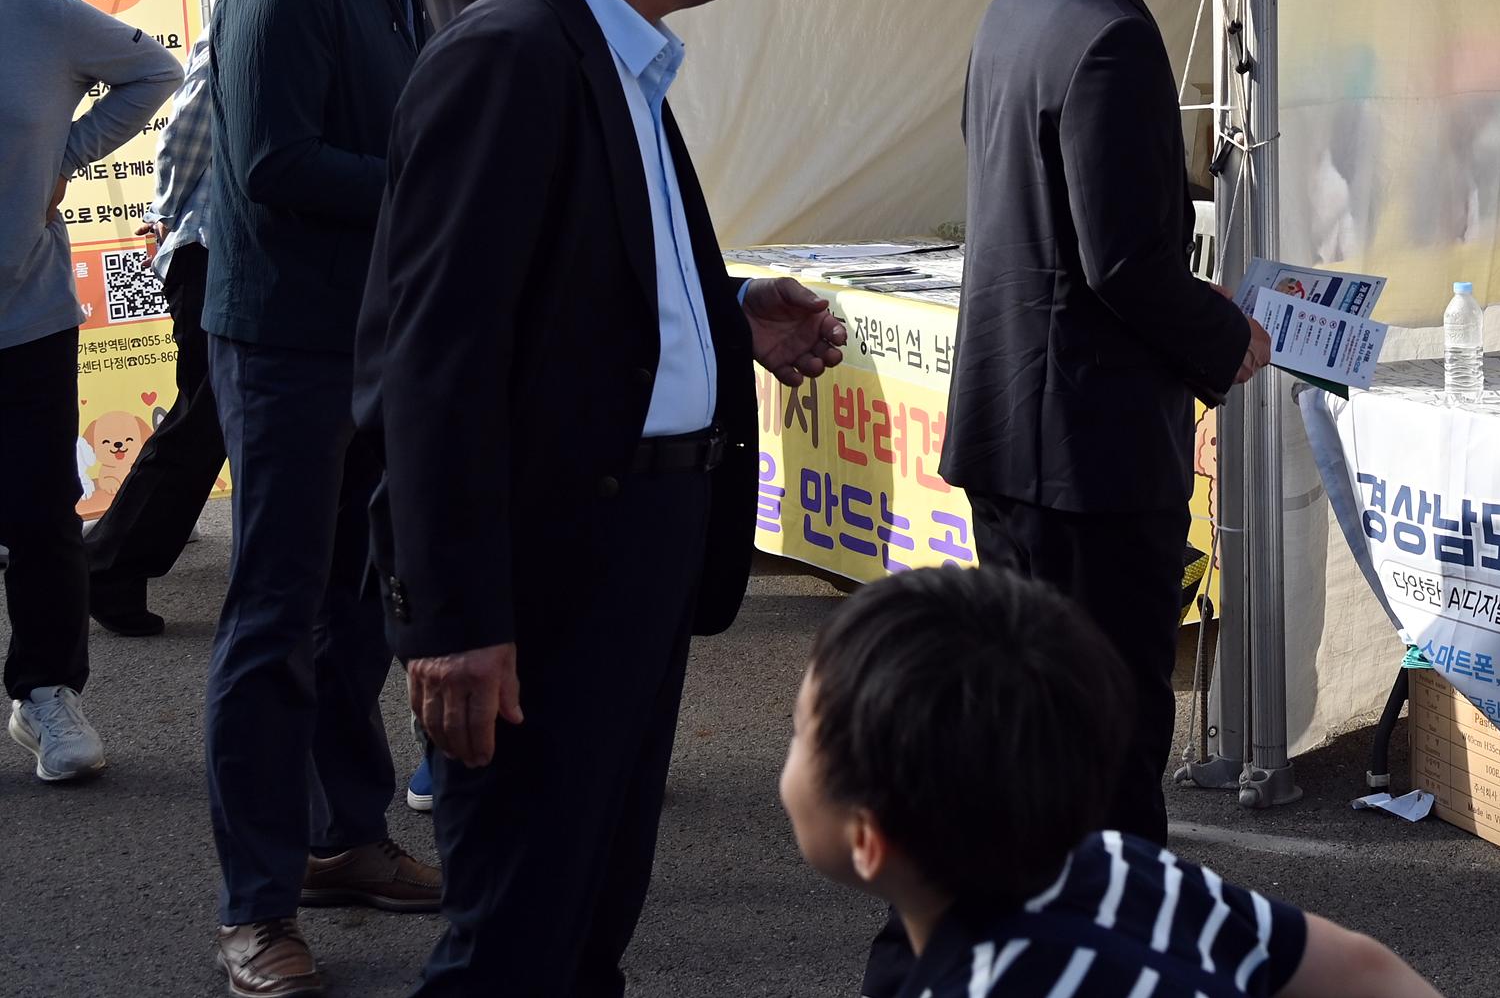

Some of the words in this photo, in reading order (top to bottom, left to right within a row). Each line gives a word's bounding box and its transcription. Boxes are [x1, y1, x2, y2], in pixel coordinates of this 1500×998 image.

[855, 315, 901, 362] 정원의
[906, 328, 930, 374] 섬,
[800, 467, 915, 572] 만드는
[1393, 570, 1441, 607] 다양한
[1420, 639, 1500, 686] 스마트폰,
[1486, 810, 1493, 822] in
